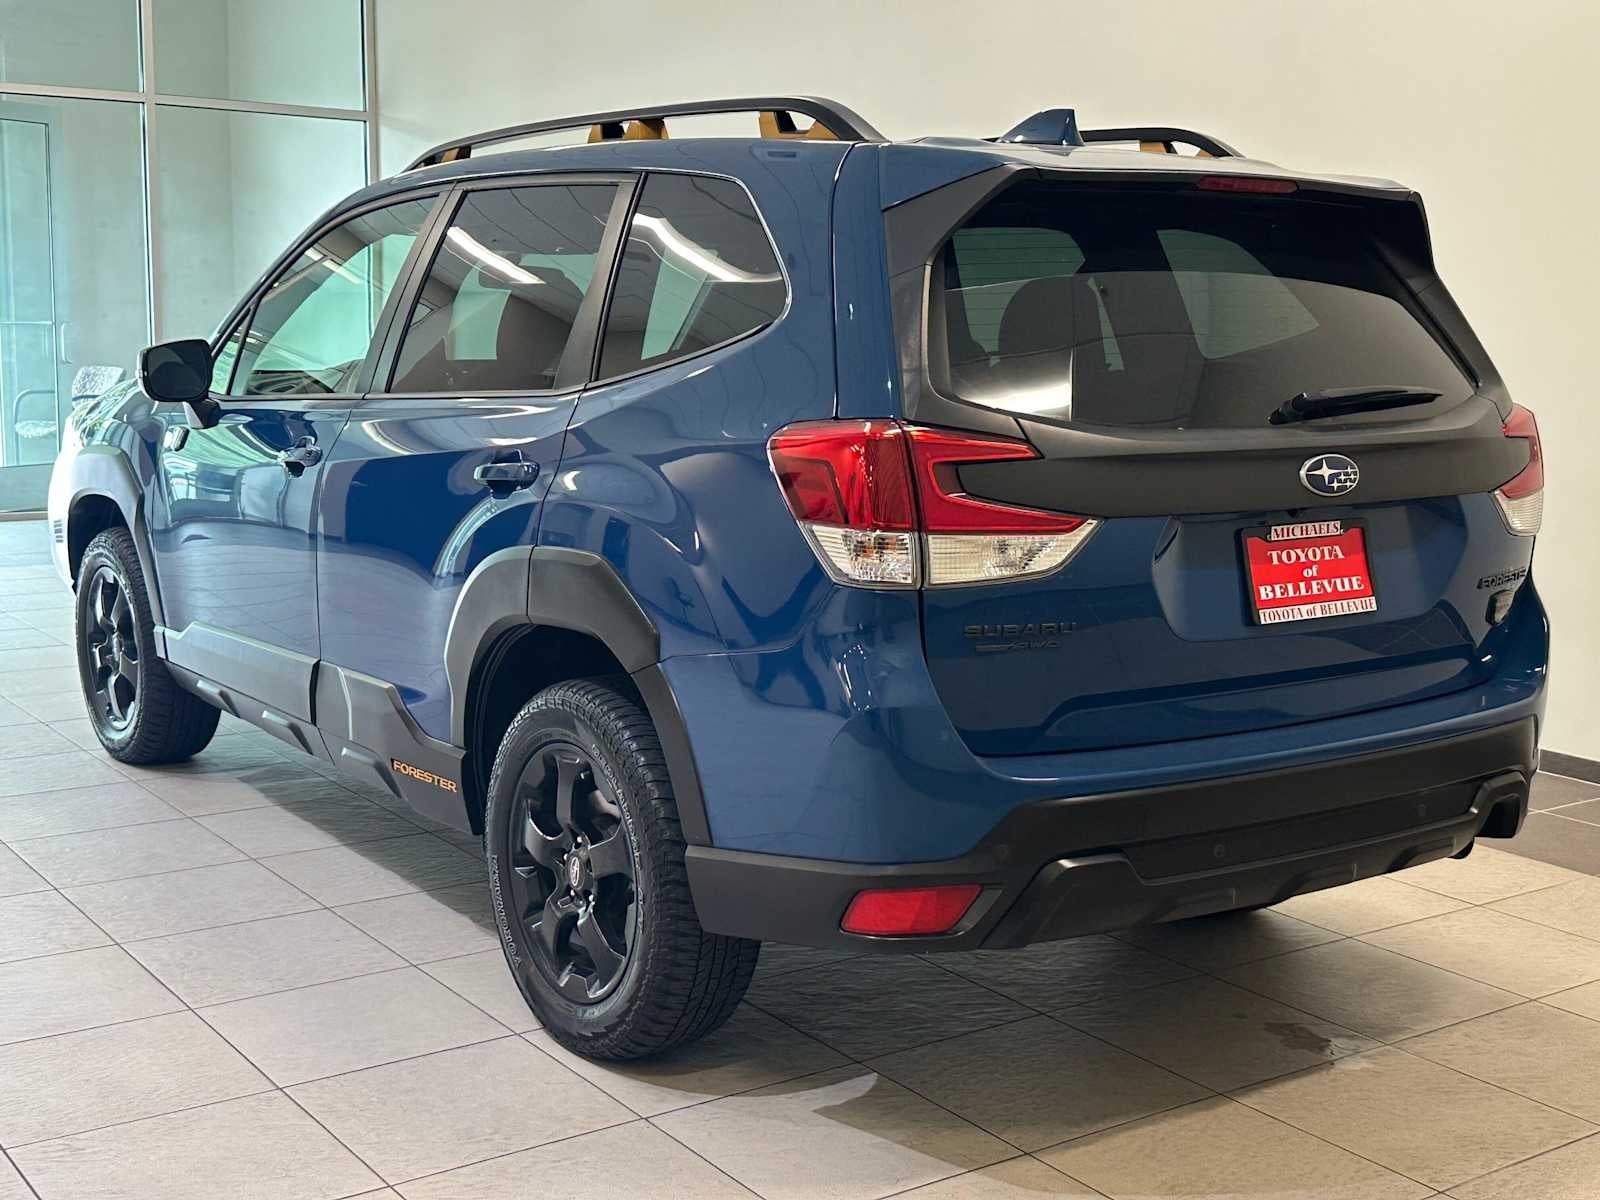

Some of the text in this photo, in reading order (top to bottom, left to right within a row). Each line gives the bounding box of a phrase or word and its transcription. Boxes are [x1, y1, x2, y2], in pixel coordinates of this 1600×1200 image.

[1272, 521, 1339, 540] MICHAELS
[1267, 545, 1345, 565] TOYOTA
[1302, 564, 1320, 578] of
[1258, 576, 1365, 601] BELLEVUE
[1260, 597, 1376, 623] TOYOTA of BELLEVUE
[964, 621, 1077, 639] SUBARU
[393, 760, 457, 793] FORESTER
